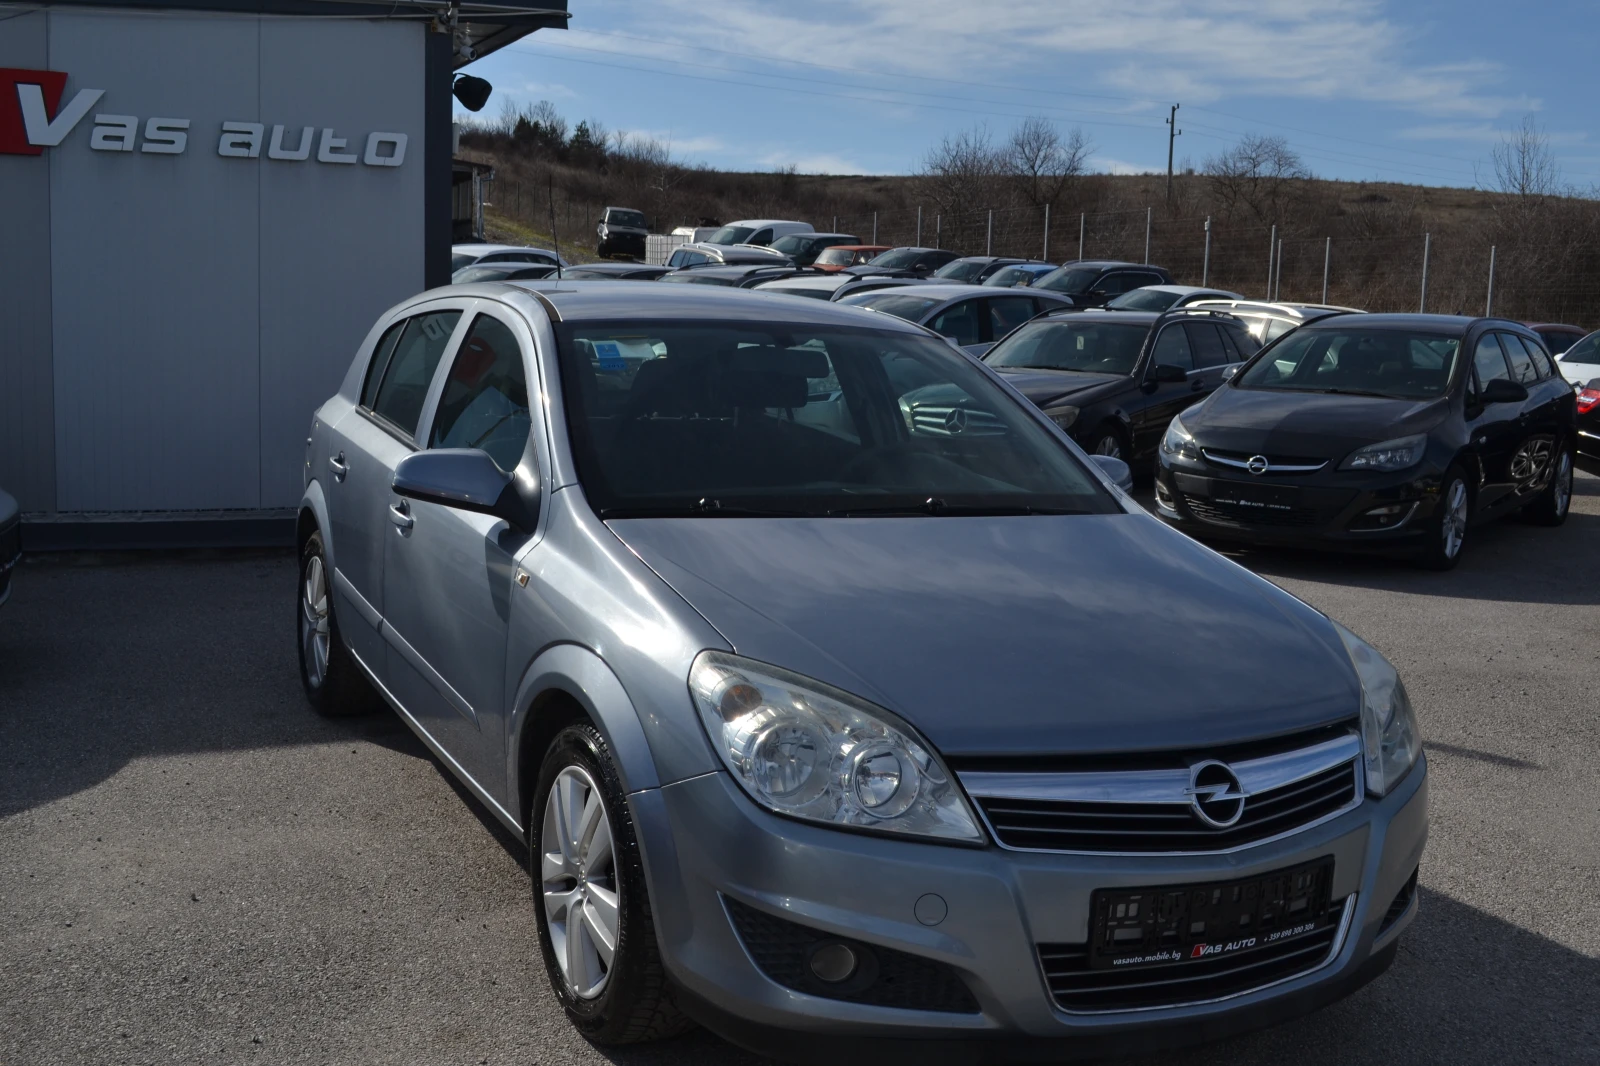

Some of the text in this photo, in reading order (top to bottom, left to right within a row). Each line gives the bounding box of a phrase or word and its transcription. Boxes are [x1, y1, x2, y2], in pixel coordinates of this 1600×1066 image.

[16, 83, 408, 168] Vas auto
[1199, 938, 1257, 956] VAS AUTO
[1113, 949, 1182, 965] vasauto.mobile.bg
